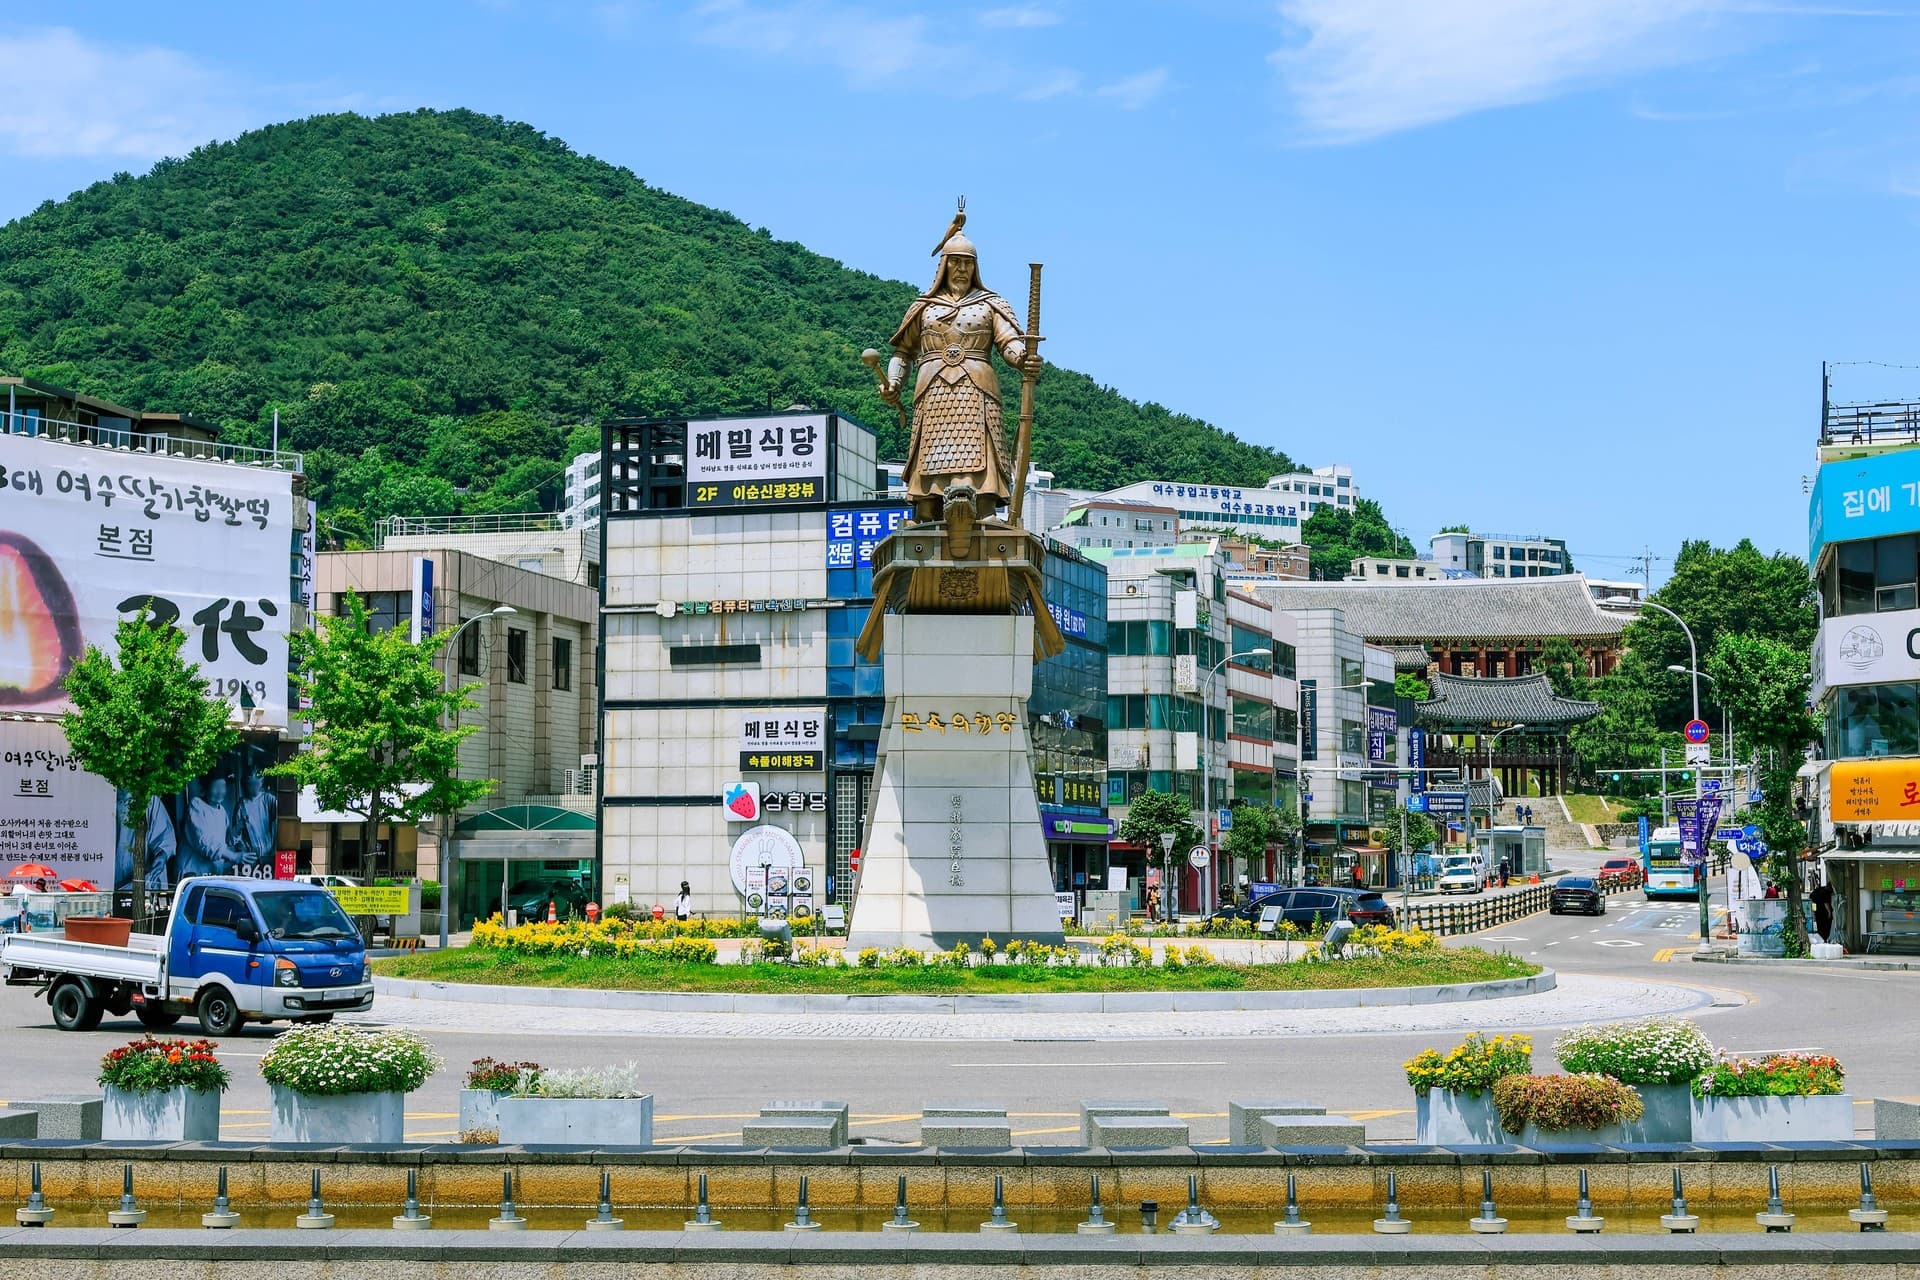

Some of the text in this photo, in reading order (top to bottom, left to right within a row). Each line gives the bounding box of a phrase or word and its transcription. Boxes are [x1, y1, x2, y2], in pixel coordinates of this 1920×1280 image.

[696, 425, 817, 460] 메밀식당
[696, 482, 815, 501] 2F 이순신광장뷰
[1843, 485, 1891, 518] 집에
[97, 523, 153, 555] 본점
[828, 543, 853, 565] 전문
[711, 599, 749, 615] 컴퓨터
[745, 720, 819, 739] 메밀식당
[1371, 738, 1383, 759] 치과
[748, 755, 815, 768] 속풀이해장국
[19, 779, 49, 793] 본점
[763, 791, 828, 812] 삼합당
[54, 830, 76, 839] 그대로
[82, 852, 104, 863] 입니다
